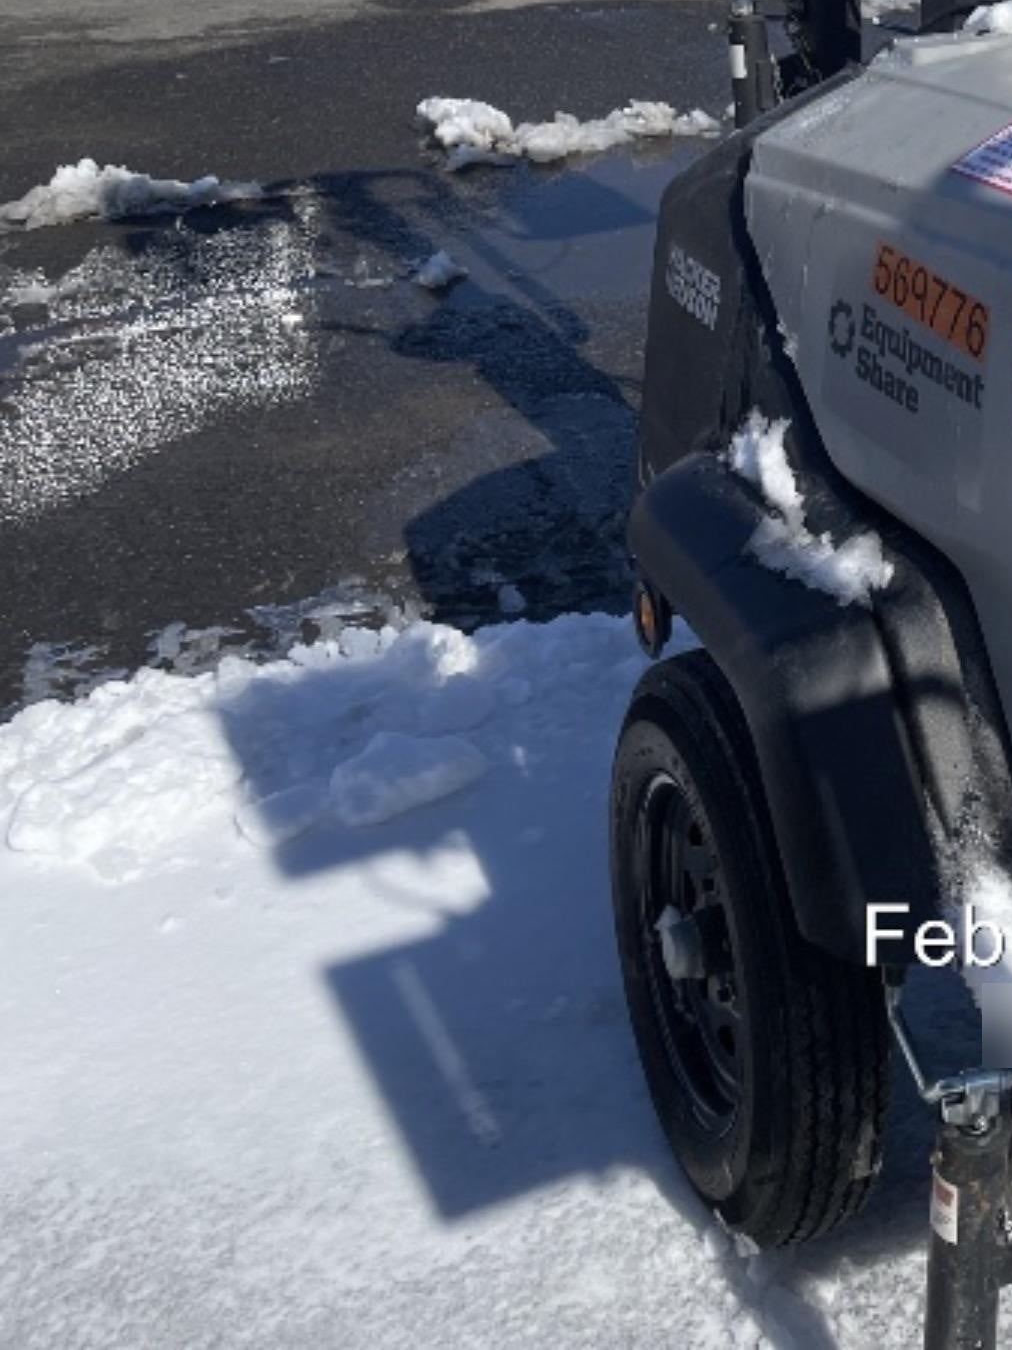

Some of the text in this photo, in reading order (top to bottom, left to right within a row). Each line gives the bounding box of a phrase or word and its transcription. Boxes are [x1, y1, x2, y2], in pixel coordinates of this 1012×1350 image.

[873, 245, 989, 358] 569776
[855, 345, 919, 413] Share
[861, 302, 985, 410] Equipment
